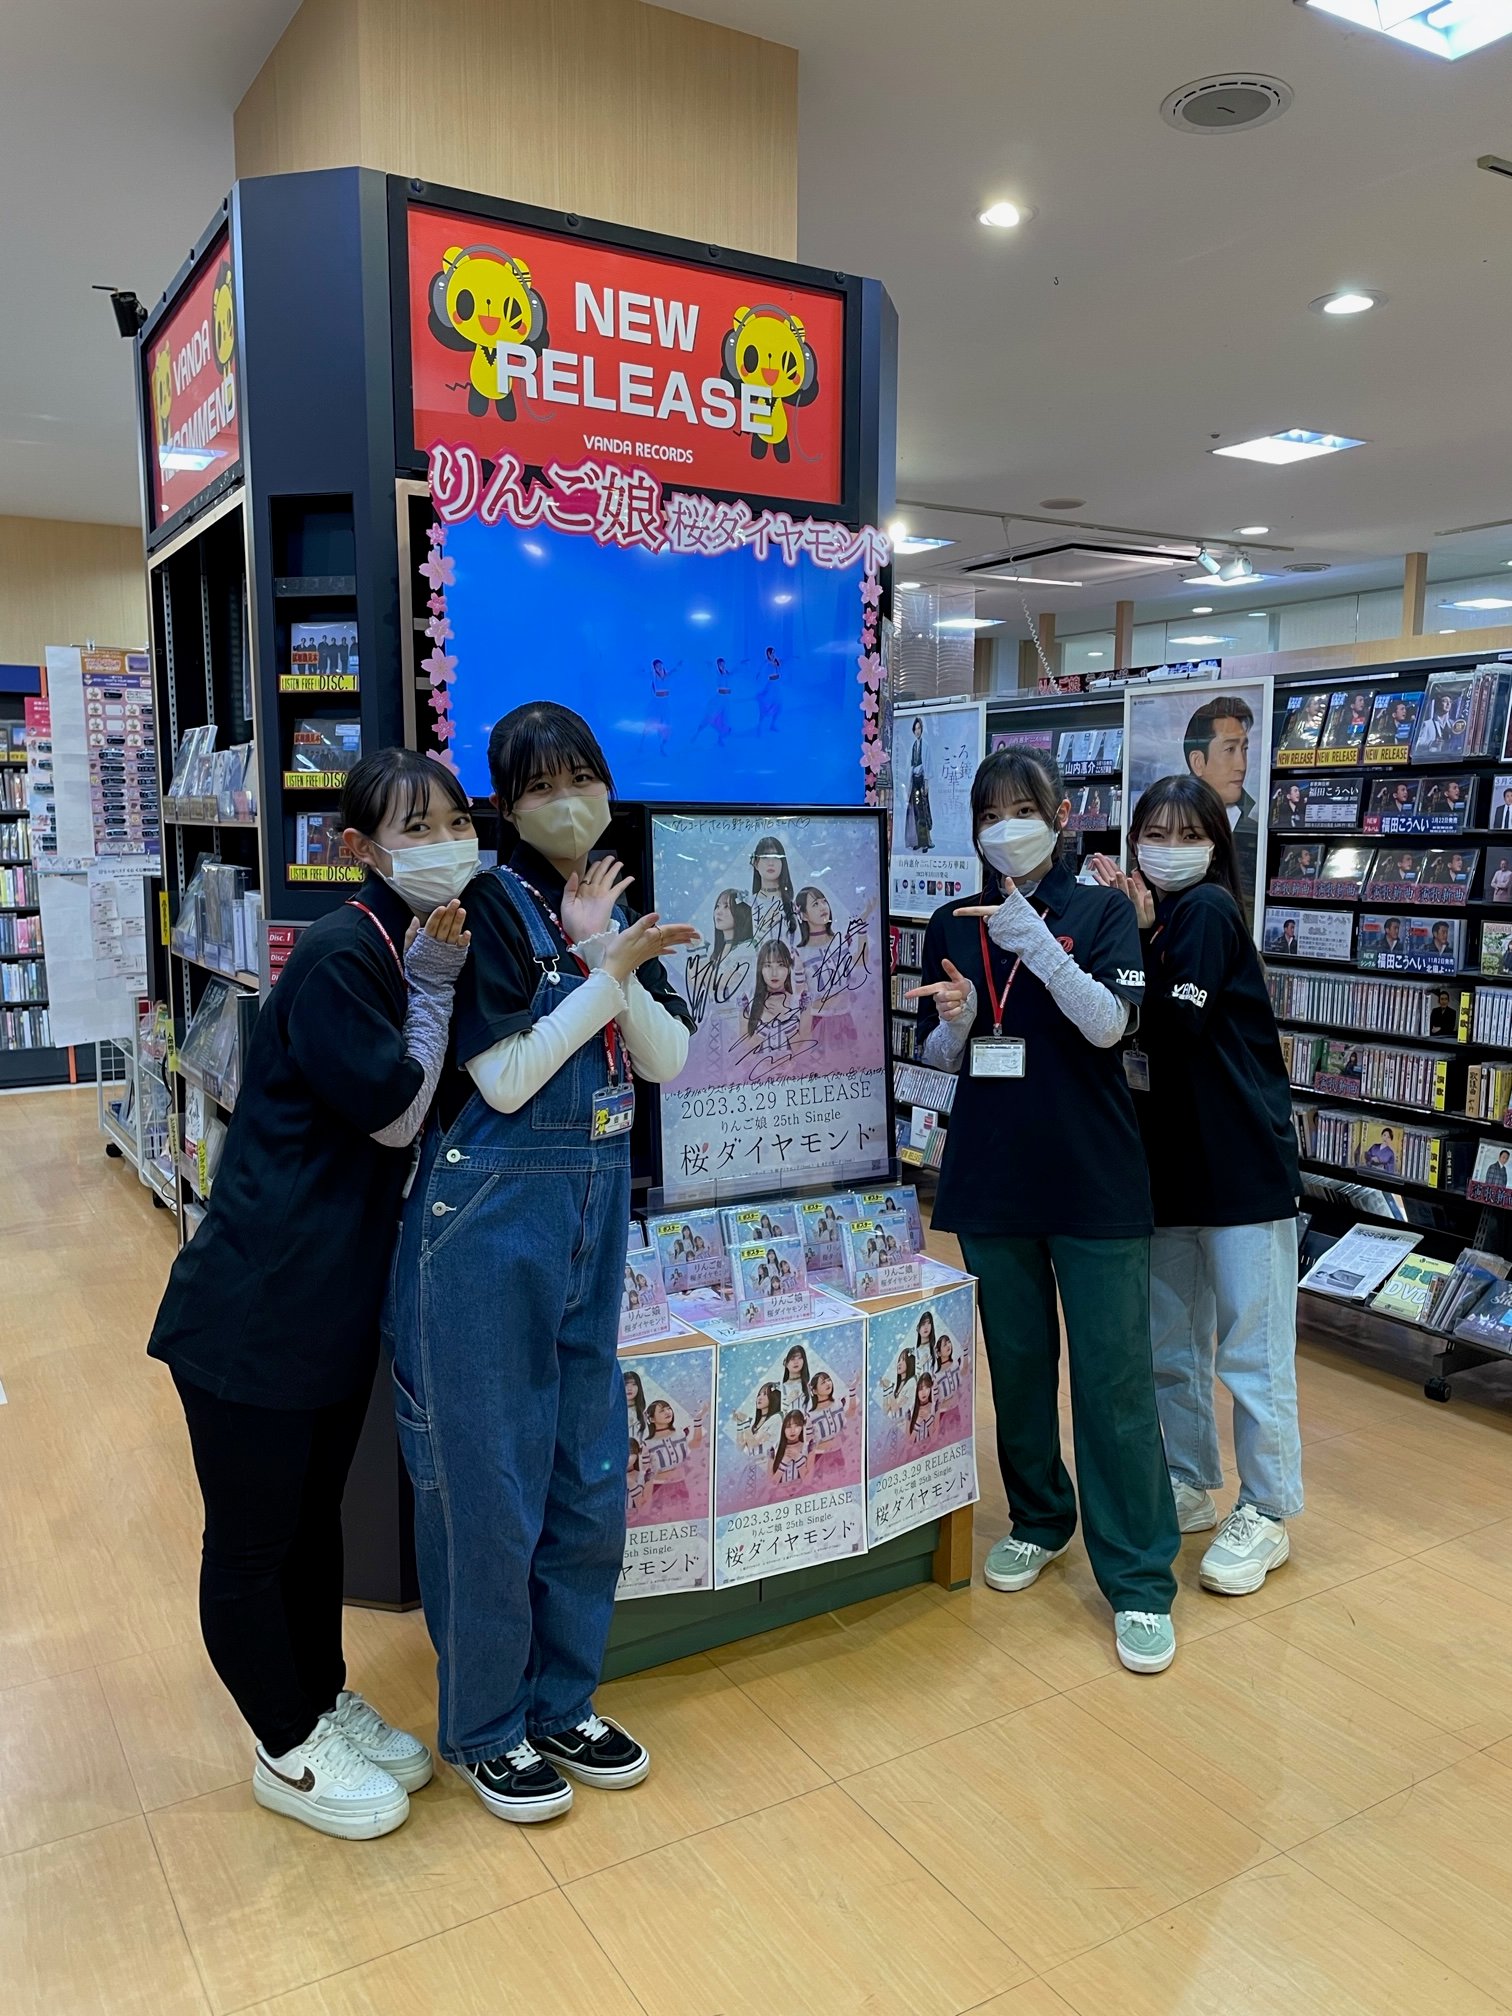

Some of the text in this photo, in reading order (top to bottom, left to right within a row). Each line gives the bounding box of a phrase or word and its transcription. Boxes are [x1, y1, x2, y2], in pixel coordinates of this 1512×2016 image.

[575, 281, 699, 352] NEW
[173, 319, 211, 396] VANDA
[496, 340, 773, 436] RELEASE
[583, 434, 693, 464] VANDA RECORDS
[429, 443, 665, 552] りんご娘
[667, 494, 890, 574] 桜ダイヤモンド
[1278, 750, 1314, 766] NEW RELEASE
[1316, 748, 1358, 764] NEW RELEASE
[1364, 746, 1408, 762] NEW RELEASE
[1382, 815, 1430, 833] 福田こうへい
[1377, 953, 1428, 972] 福田こうへい
[681, 1081, 872, 1120] 2023.3.29 RELEASE
[720, 1109, 841, 1134] りんご娘 25th Single
[680, 1123, 876, 1176] 桜ダイヤモンド
[876, 1444, 968, 1494] 2023.3.29 RELEASE
[727, 1491, 854, 1533] 2023.3.29 RELEASE
[876, 1471, 969, 1527] 桜ダイヤモンド
[629, 1524, 698, 1546] RELEASE
[786, 1518, 804, 1531] 25th
[807, 1513, 833, 1526] Single
[643, 1545, 672, 1557] Single
[726, 1519, 856, 1569] 桜ダイヤモンド
